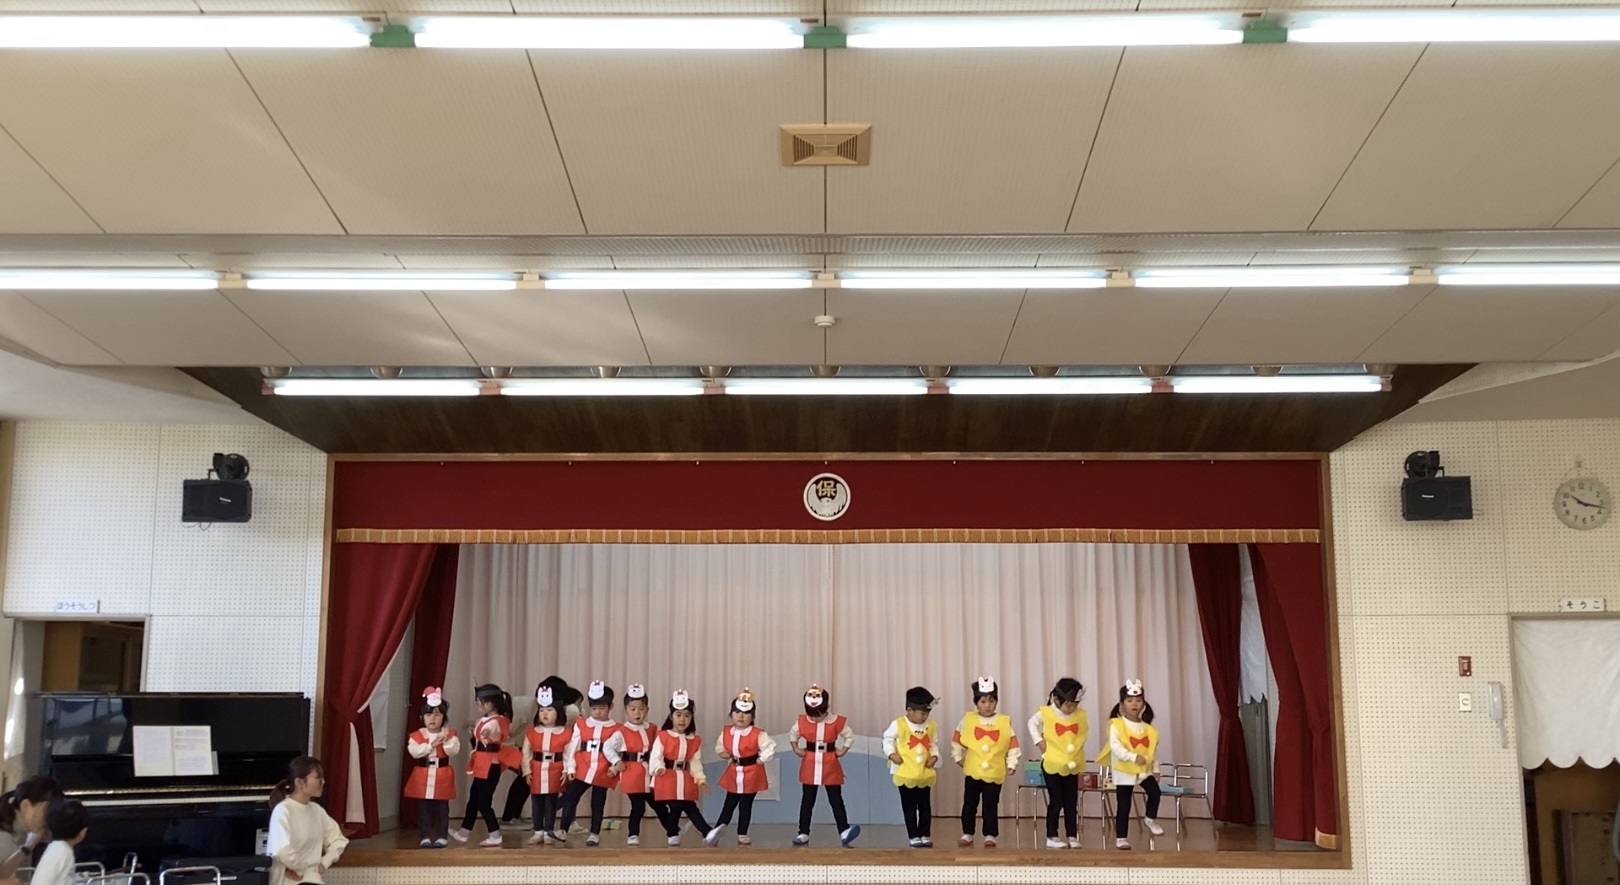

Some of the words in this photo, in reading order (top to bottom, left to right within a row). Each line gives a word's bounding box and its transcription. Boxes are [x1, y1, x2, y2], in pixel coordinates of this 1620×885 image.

[816, 480, 837, 497] 保
[1566, 600, 1601, 609] そうこ
